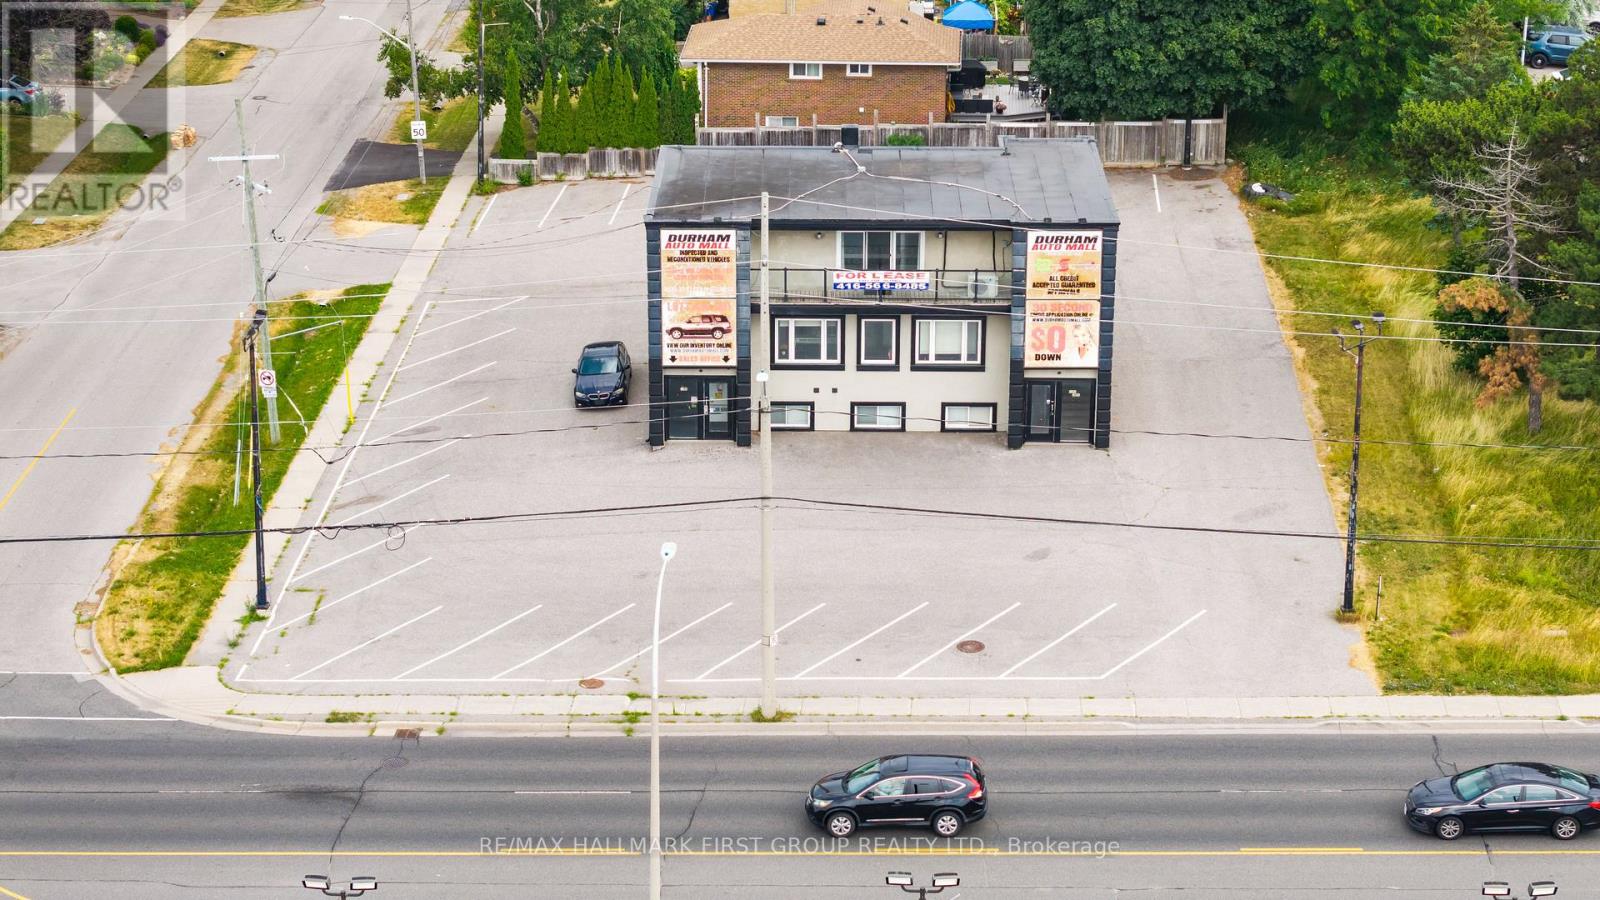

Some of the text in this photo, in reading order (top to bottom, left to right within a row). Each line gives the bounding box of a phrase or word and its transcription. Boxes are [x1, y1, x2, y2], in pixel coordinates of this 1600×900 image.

[413, 128, 424, 136] 50
[668, 234, 731, 242] DURHAM
[1035, 235, 1098, 243] DURHAM
